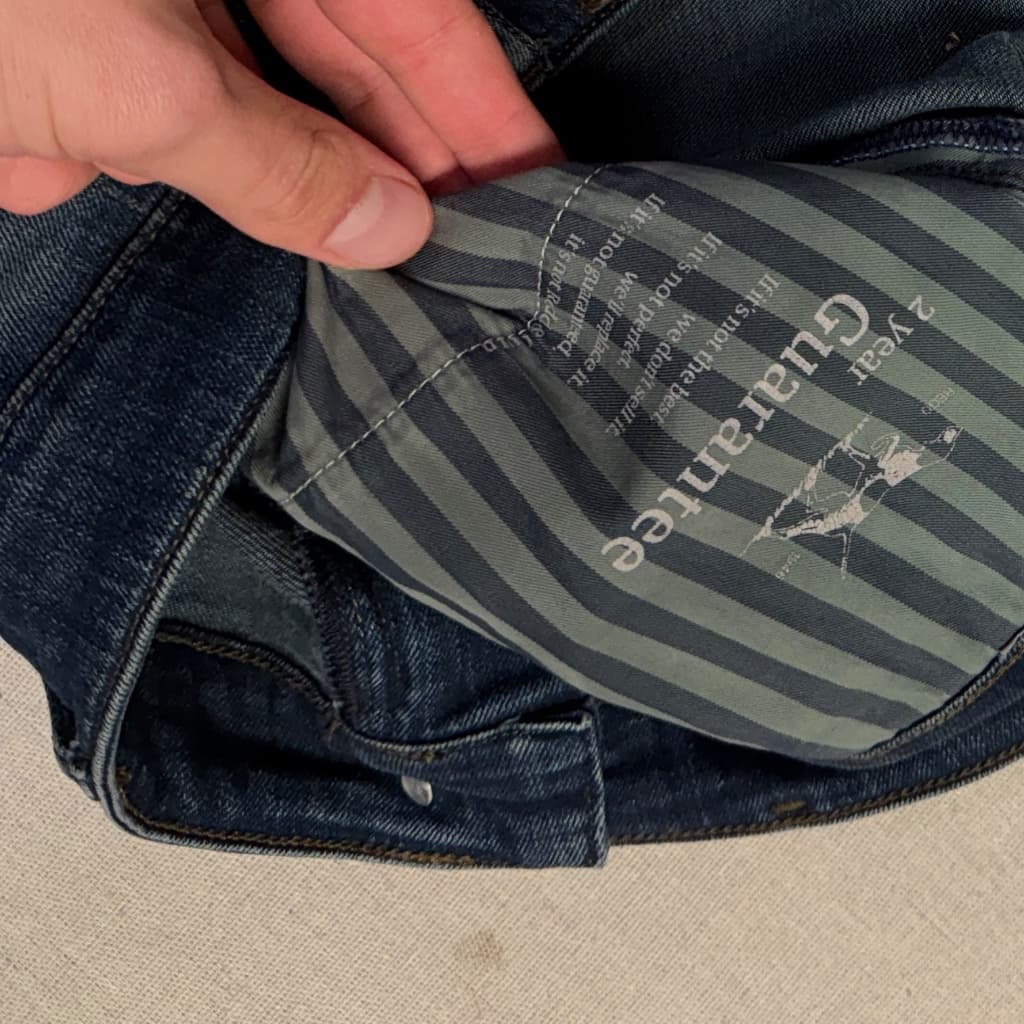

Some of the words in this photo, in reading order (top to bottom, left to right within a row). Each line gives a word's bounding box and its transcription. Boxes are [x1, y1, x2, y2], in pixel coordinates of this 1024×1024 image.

[644, 192, 666, 214] If
[558, 233, 586, 262] it's
[592, 231, 625, 270] not
[701, 231, 722, 254] If
[548, 260, 567, 292] not
[677, 246, 709, 274] it's
[608, 271, 638, 317] we'll
[648, 271, 683, 307] not
[759, 274, 781, 297] If
[735, 289, 767, 318] it's
[908, 295, 935, 321] 2
[584, 311, 615, 372] replace
[667, 314, 695, 343] we
[706, 315, 741, 352] not
[847, 313, 914, 386] year
[640, 342, 672, 391] don't
[680, 351, 713, 384] the
[620, 385, 645, 424] sell
[602, 294, 870, 572] Guarantee
